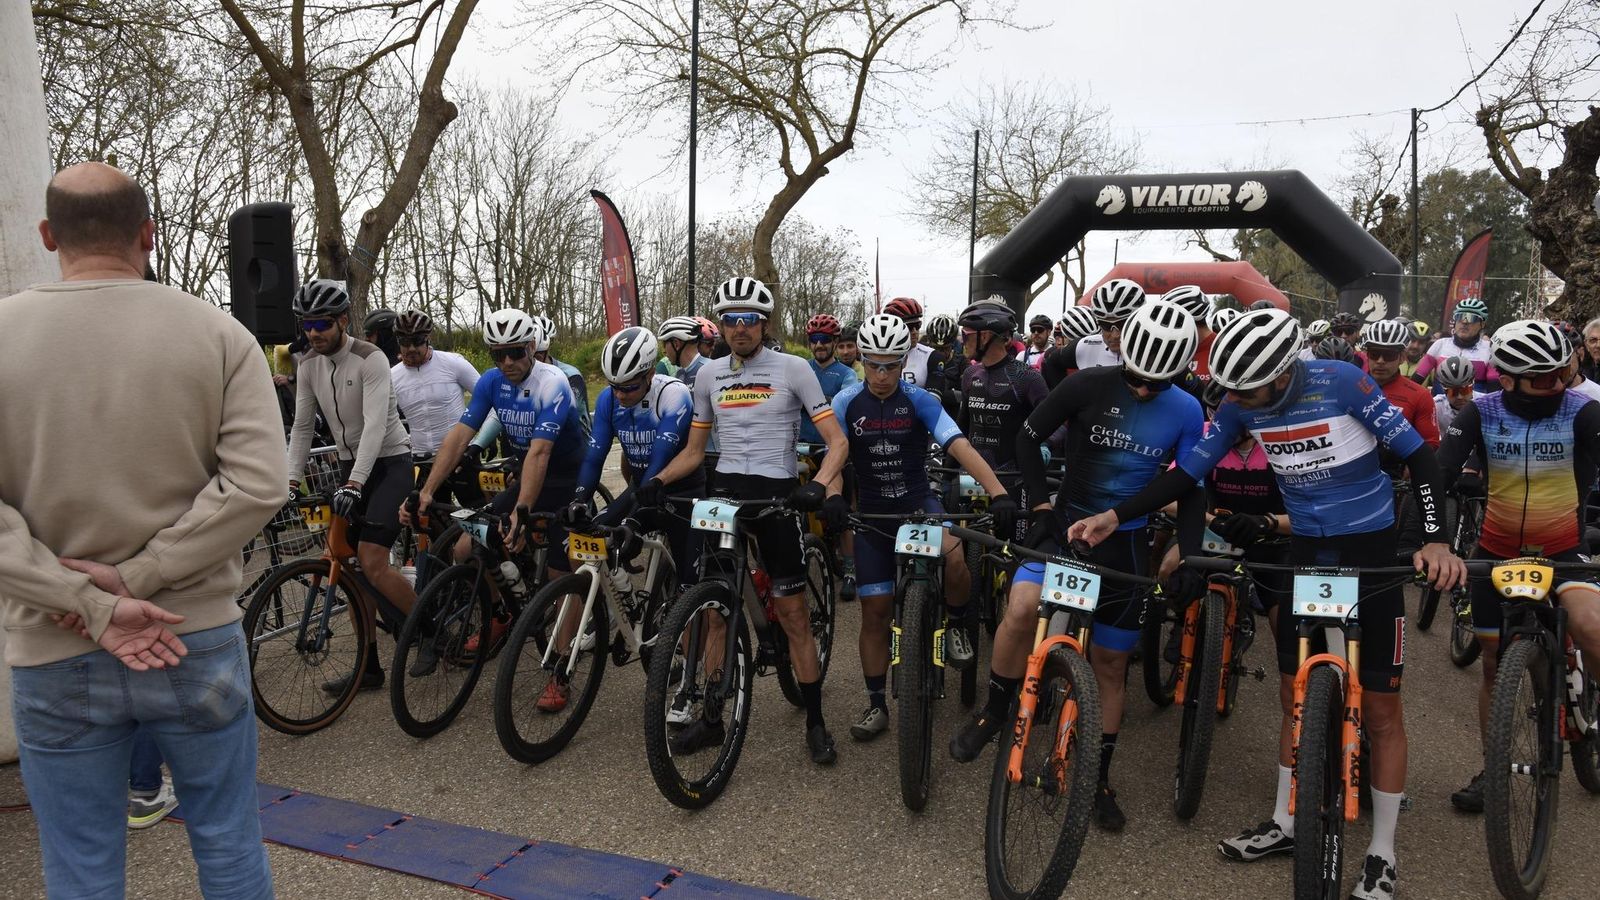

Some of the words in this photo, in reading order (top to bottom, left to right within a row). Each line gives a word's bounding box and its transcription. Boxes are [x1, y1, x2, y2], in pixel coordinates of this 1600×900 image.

[1131, 183, 1232, 207] VIATOR
[1133, 206, 1185, 214] EQUIPAMIENTO
[1187, 205, 1230, 213] DEPORTIVO
[725, 393, 771, 401] BUJARKAY
[497, 408, 535, 426] FERNANDO
[505, 423, 533, 438] TORRES
[1091, 424, 1132, 441] Ciclos
[1089, 433, 1164, 458] CABELLO
[1264, 436, 1334, 456] SOUDAL
[1532, 442, 1565, 455] POZO
[871, 460, 903, 468] MONKEY
[482, 475, 501, 484] 314
[1419, 483, 1434, 522] PISSEI
[708, 506, 719, 517] 4
[909, 529, 929, 542] 21
[574, 538, 600, 552] 318
[1054, 571, 1092, 593] 187
[1501, 570, 1543, 583] 319
[1318, 582, 1333, 599] 3
[1012, 716, 1028, 749] FOX
[1350, 752, 1361, 788] FOX
